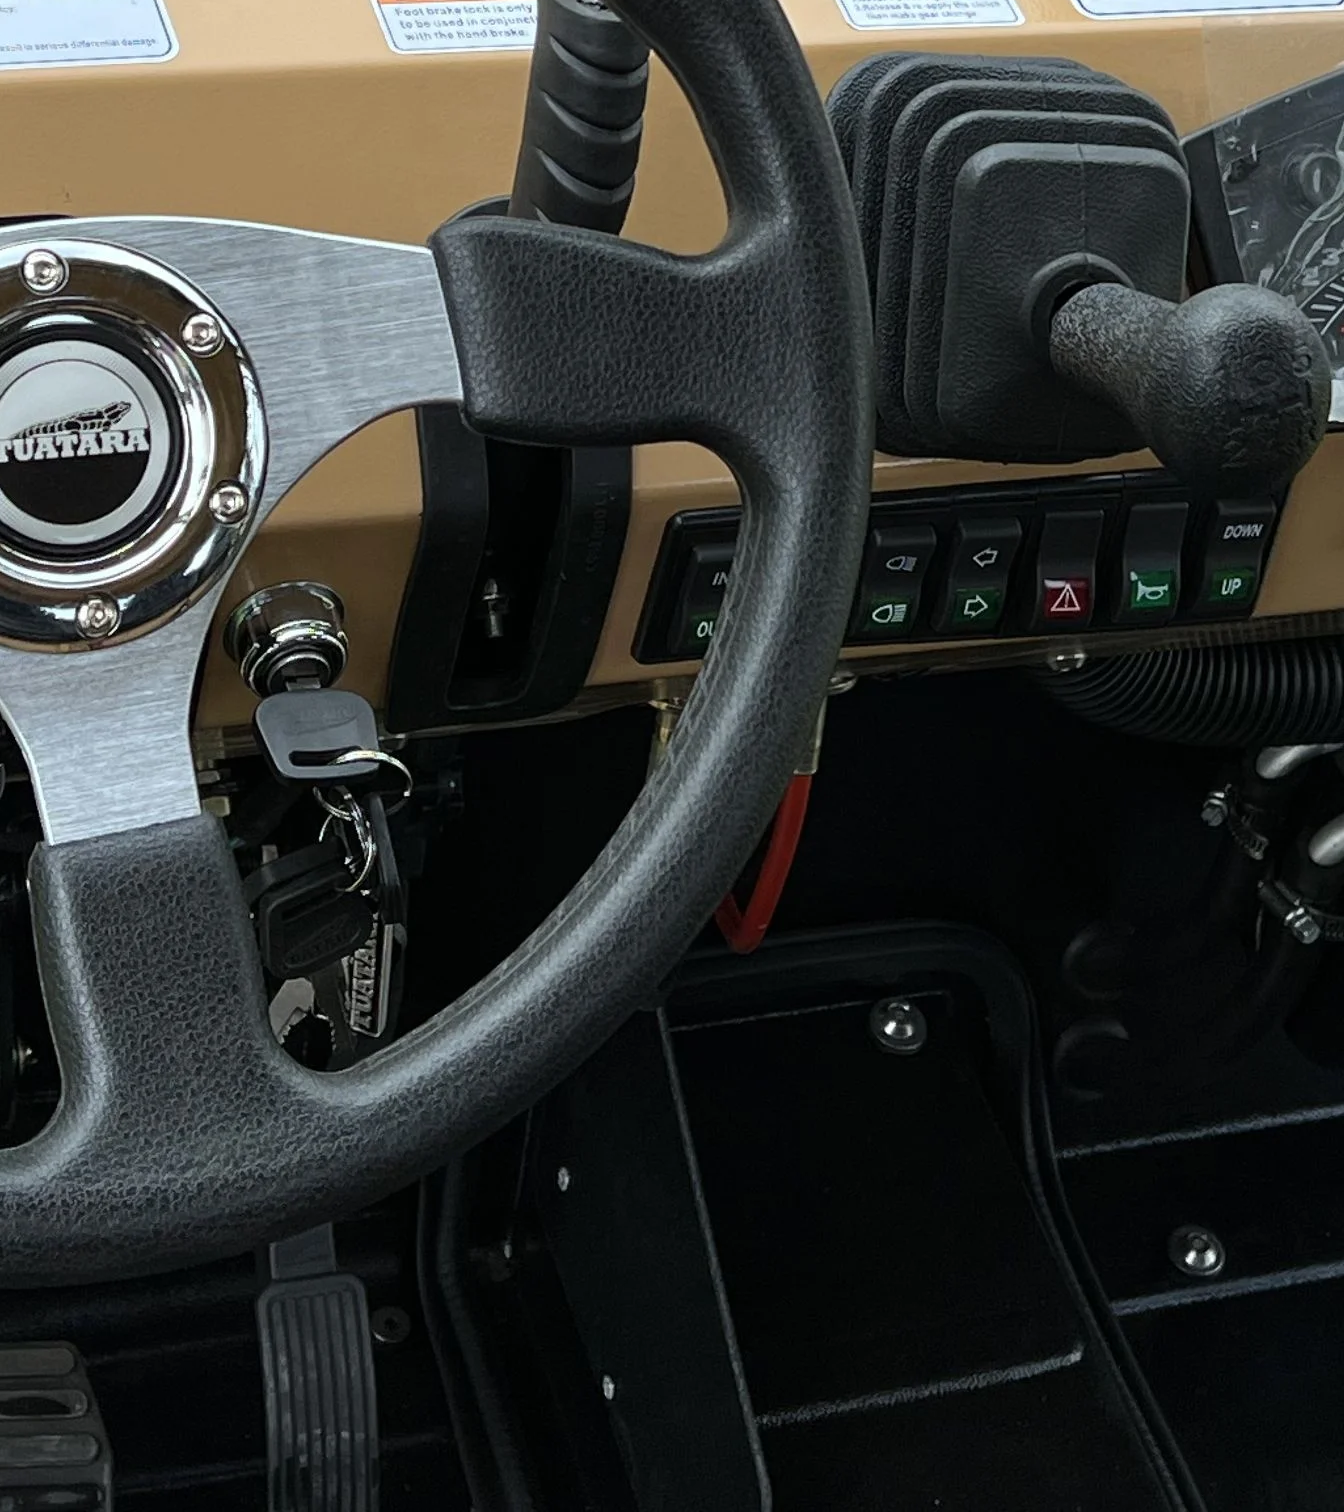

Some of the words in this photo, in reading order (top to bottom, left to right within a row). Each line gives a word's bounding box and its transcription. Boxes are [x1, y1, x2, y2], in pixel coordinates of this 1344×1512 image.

[427, 6, 461, 16] brake
[400, 20, 412, 29] to
[415, 19, 431, 29] be
[481, 14, 538, 28] conjunct
[406, 31, 432, 41] with
[435, 29, 454, 39] the
[1322, 248, 1340, 266] 3
[1223, 523, 1264, 539] DOWN
[1221, 577, 1242, 595] UP
